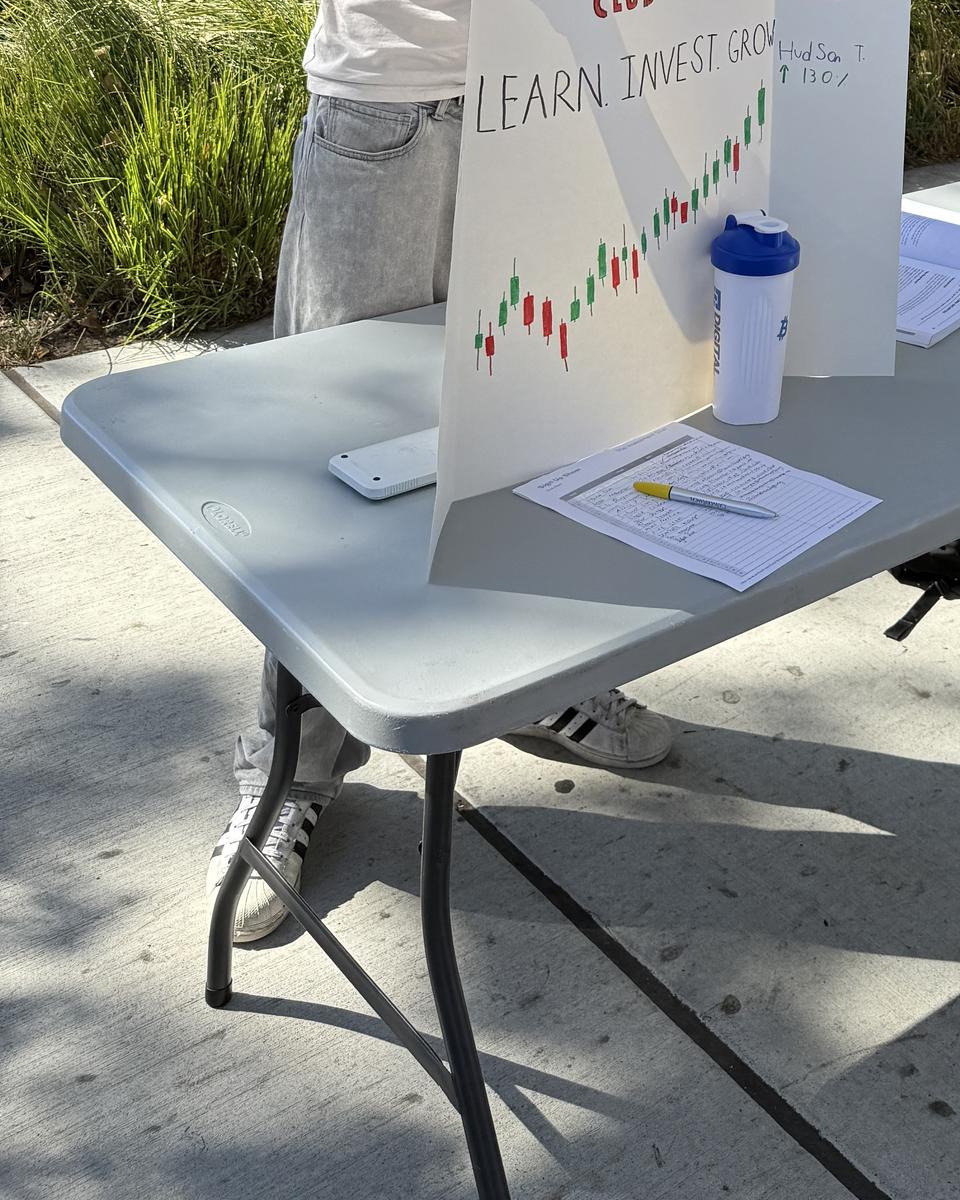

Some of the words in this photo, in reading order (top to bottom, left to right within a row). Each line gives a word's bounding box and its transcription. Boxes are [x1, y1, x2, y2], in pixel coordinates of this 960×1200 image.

[477, 64, 608, 132] LEARN.
[621, 33, 720, 101] INVEST.
[728, 19, 776, 64] GROW
